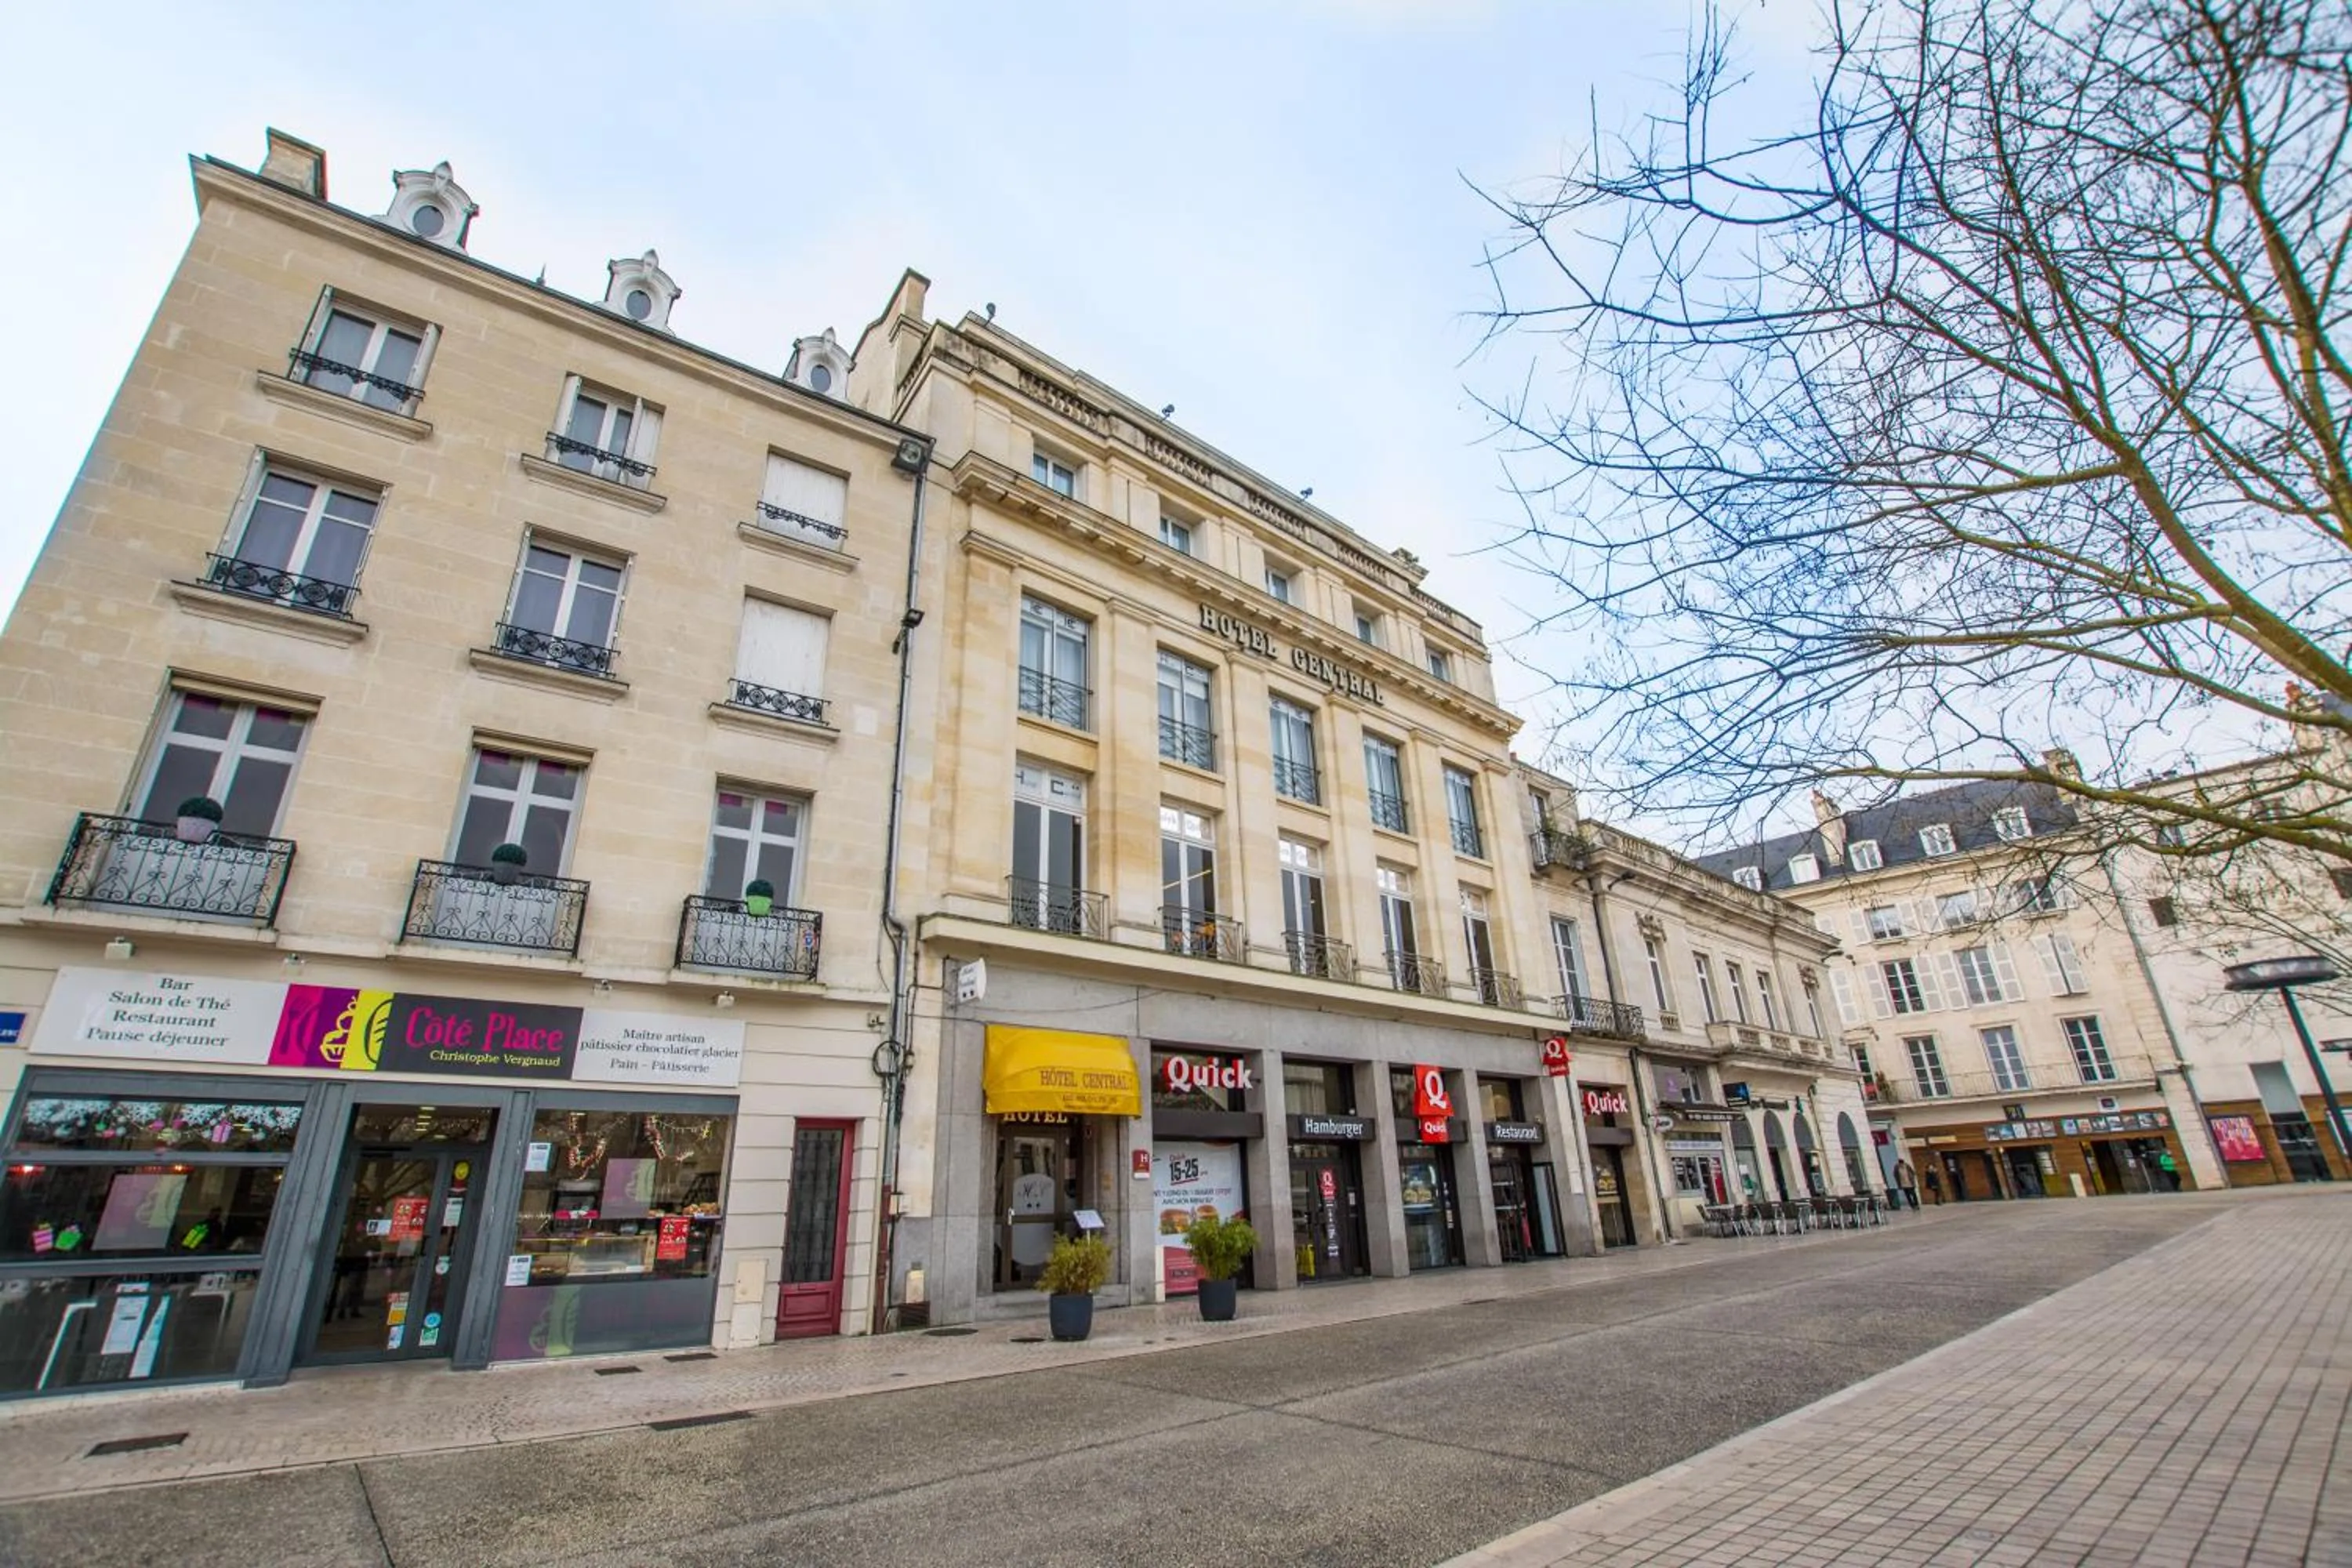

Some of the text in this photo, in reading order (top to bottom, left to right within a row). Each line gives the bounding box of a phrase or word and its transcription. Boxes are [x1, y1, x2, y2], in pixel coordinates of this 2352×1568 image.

[1200, 602, 1385, 706] HOTEL CENTRAL
[159, 977, 194, 990] Bar
[108, 990, 231, 1011] Salon de Thé
[112, 1009, 216, 1028] Restaurant
[405, 1005, 564, 1052] Côté Place
[86, 1027, 230, 1047] Pause déjeuner
[623, 1028, 706, 1044] Maître artisan
[429, 1049, 561, 1067] Christophe Vergnaud
[579, 1038, 740, 1059] pâtissier chocolatier glacier
[1545, 1040, 1563, 1058] Q
[609, 1058, 639, 1070] Pain
[652, 1060, 710, 1073] Pâtisserie
[1165, 1055, 1254, 1093] Quick
[1040, 1069, 1129, 1090] HÔTEL CENTRAL
[1425, 1070, 1447, 1110] Q
[1587, 1091, 1628, 1116] Quick
[1305, 1118, 1363, 1137] Hamburger
[1141, 1152, 1149, 1163] H
[1170, 1158, 1199, 1181] 15-25
